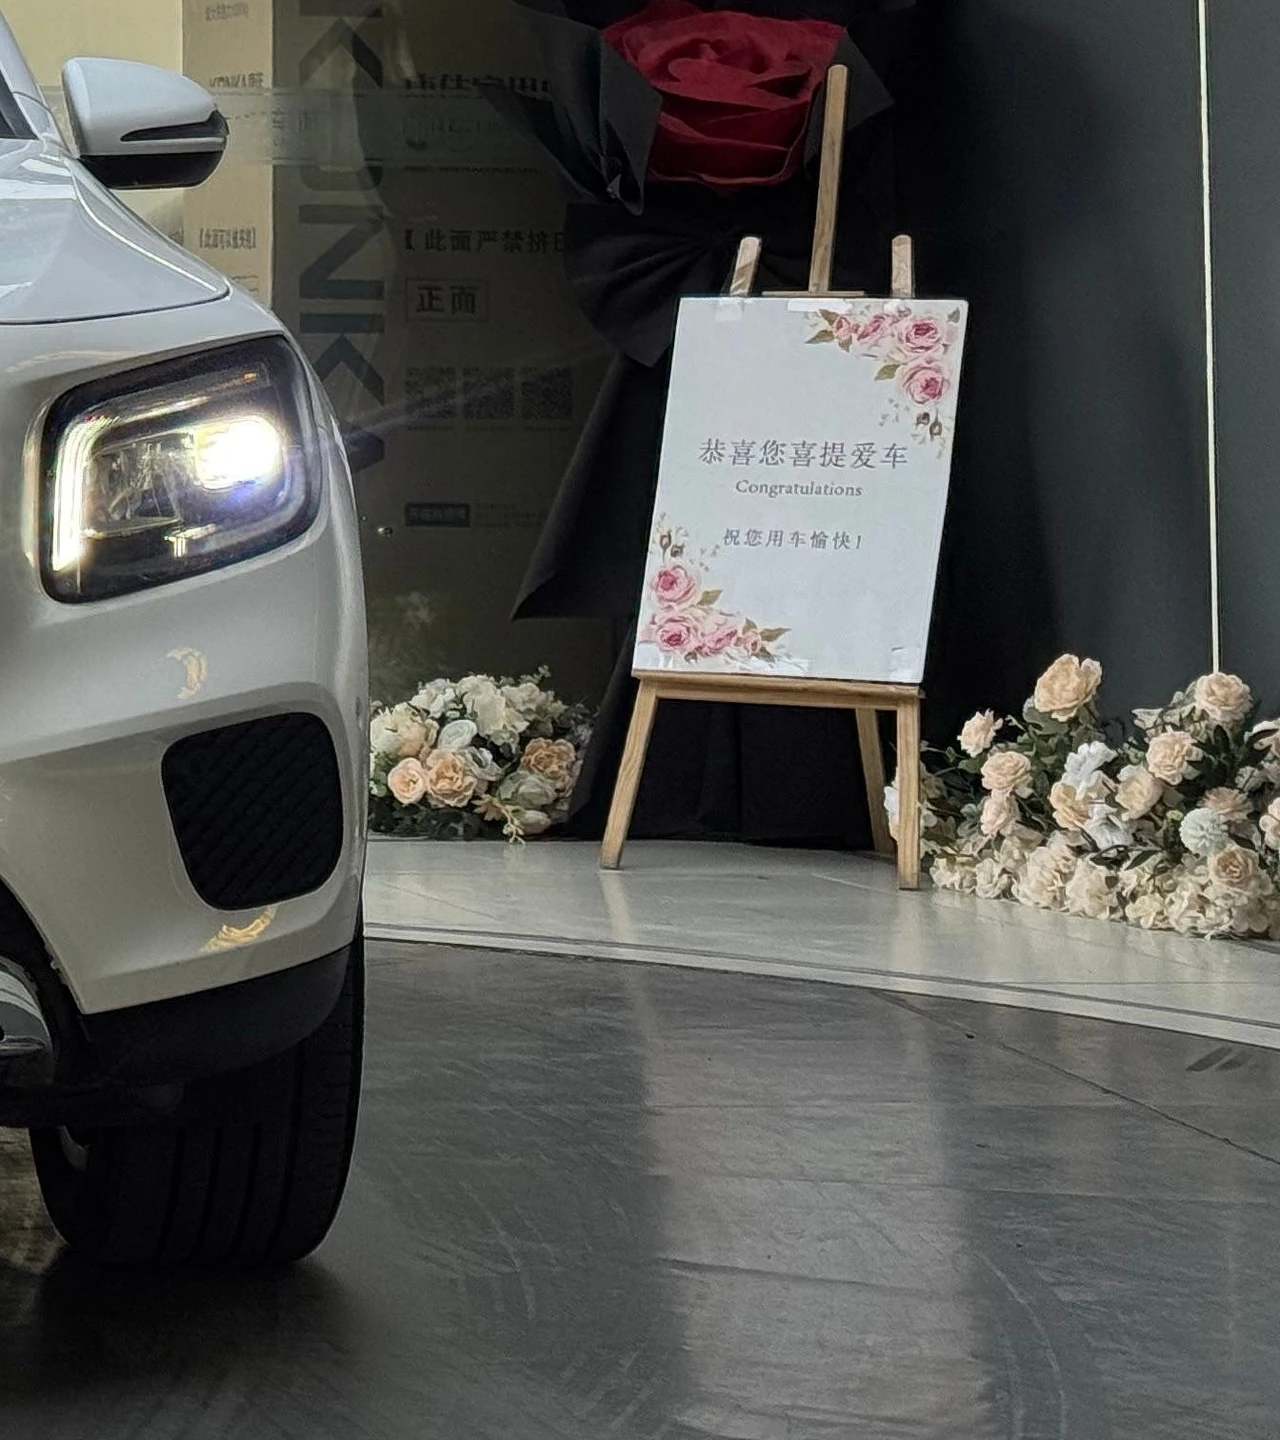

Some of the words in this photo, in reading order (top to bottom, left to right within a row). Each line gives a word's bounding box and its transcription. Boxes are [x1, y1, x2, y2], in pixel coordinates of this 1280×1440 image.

[415, 285, 478, 315] 正面
[699, 437, 909, 471] 恭喜您喜提爱车
[735, 479, 863, 499] Congratulations
